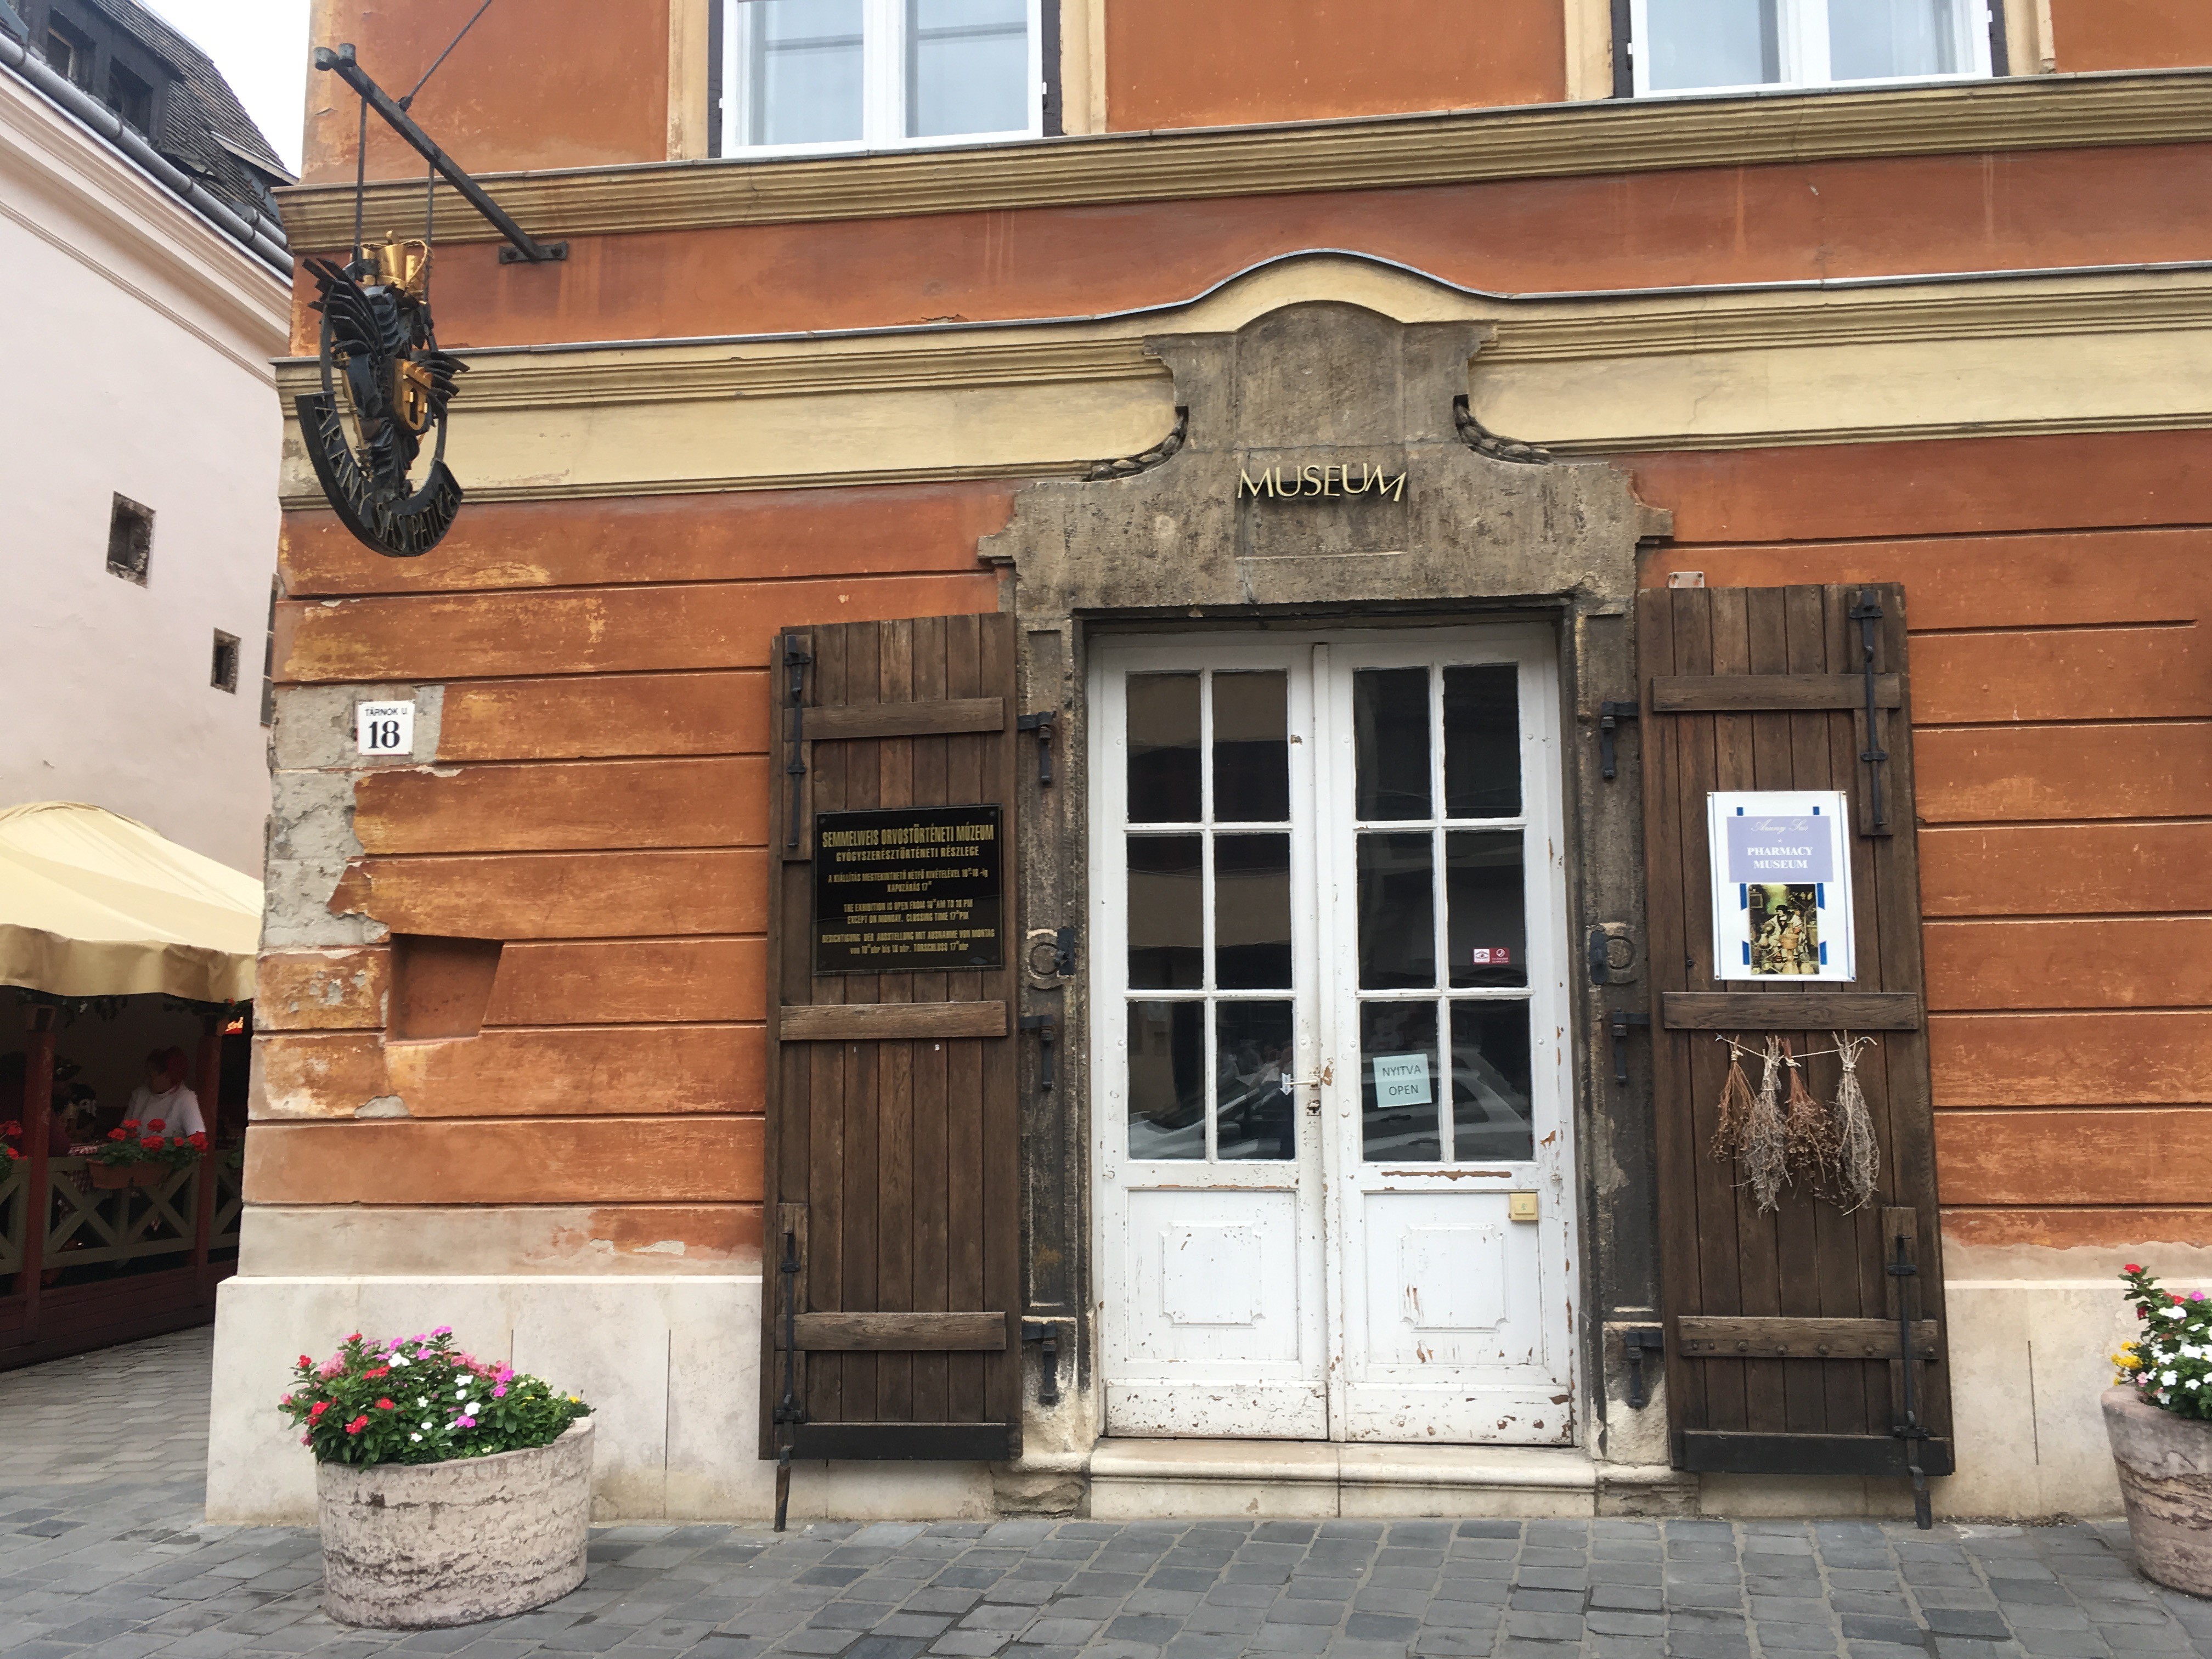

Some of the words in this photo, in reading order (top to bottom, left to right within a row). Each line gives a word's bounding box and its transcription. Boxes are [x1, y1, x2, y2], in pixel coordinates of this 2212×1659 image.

[314, 405, 373, 516] ARANY
[1238, 463, 1407, 502] MUSEUM
[364, 707, 398, 716] TÁRNOK
[368, 720, 400, 749] 18
[1751, 819, 1786, 834] Arany
[1789, 819, 1808, 832] Sas
[822, 830, 878, 848] SEMMELWEIS
[881, 823, 954, 845] ORVOSTÖRTÉNETI
[956, 821, 994, 841] MÚZEUM
[940, 845, 979, 857] RÉSZLEGE
[1746, 847, 1813, 856] PHARMACY
[1753, 860, 1808, 869] MUSEUM
[1382, 1065, 1422, 1077] NYITVA
[1389, 1084, 1419, 1096] OPEN
